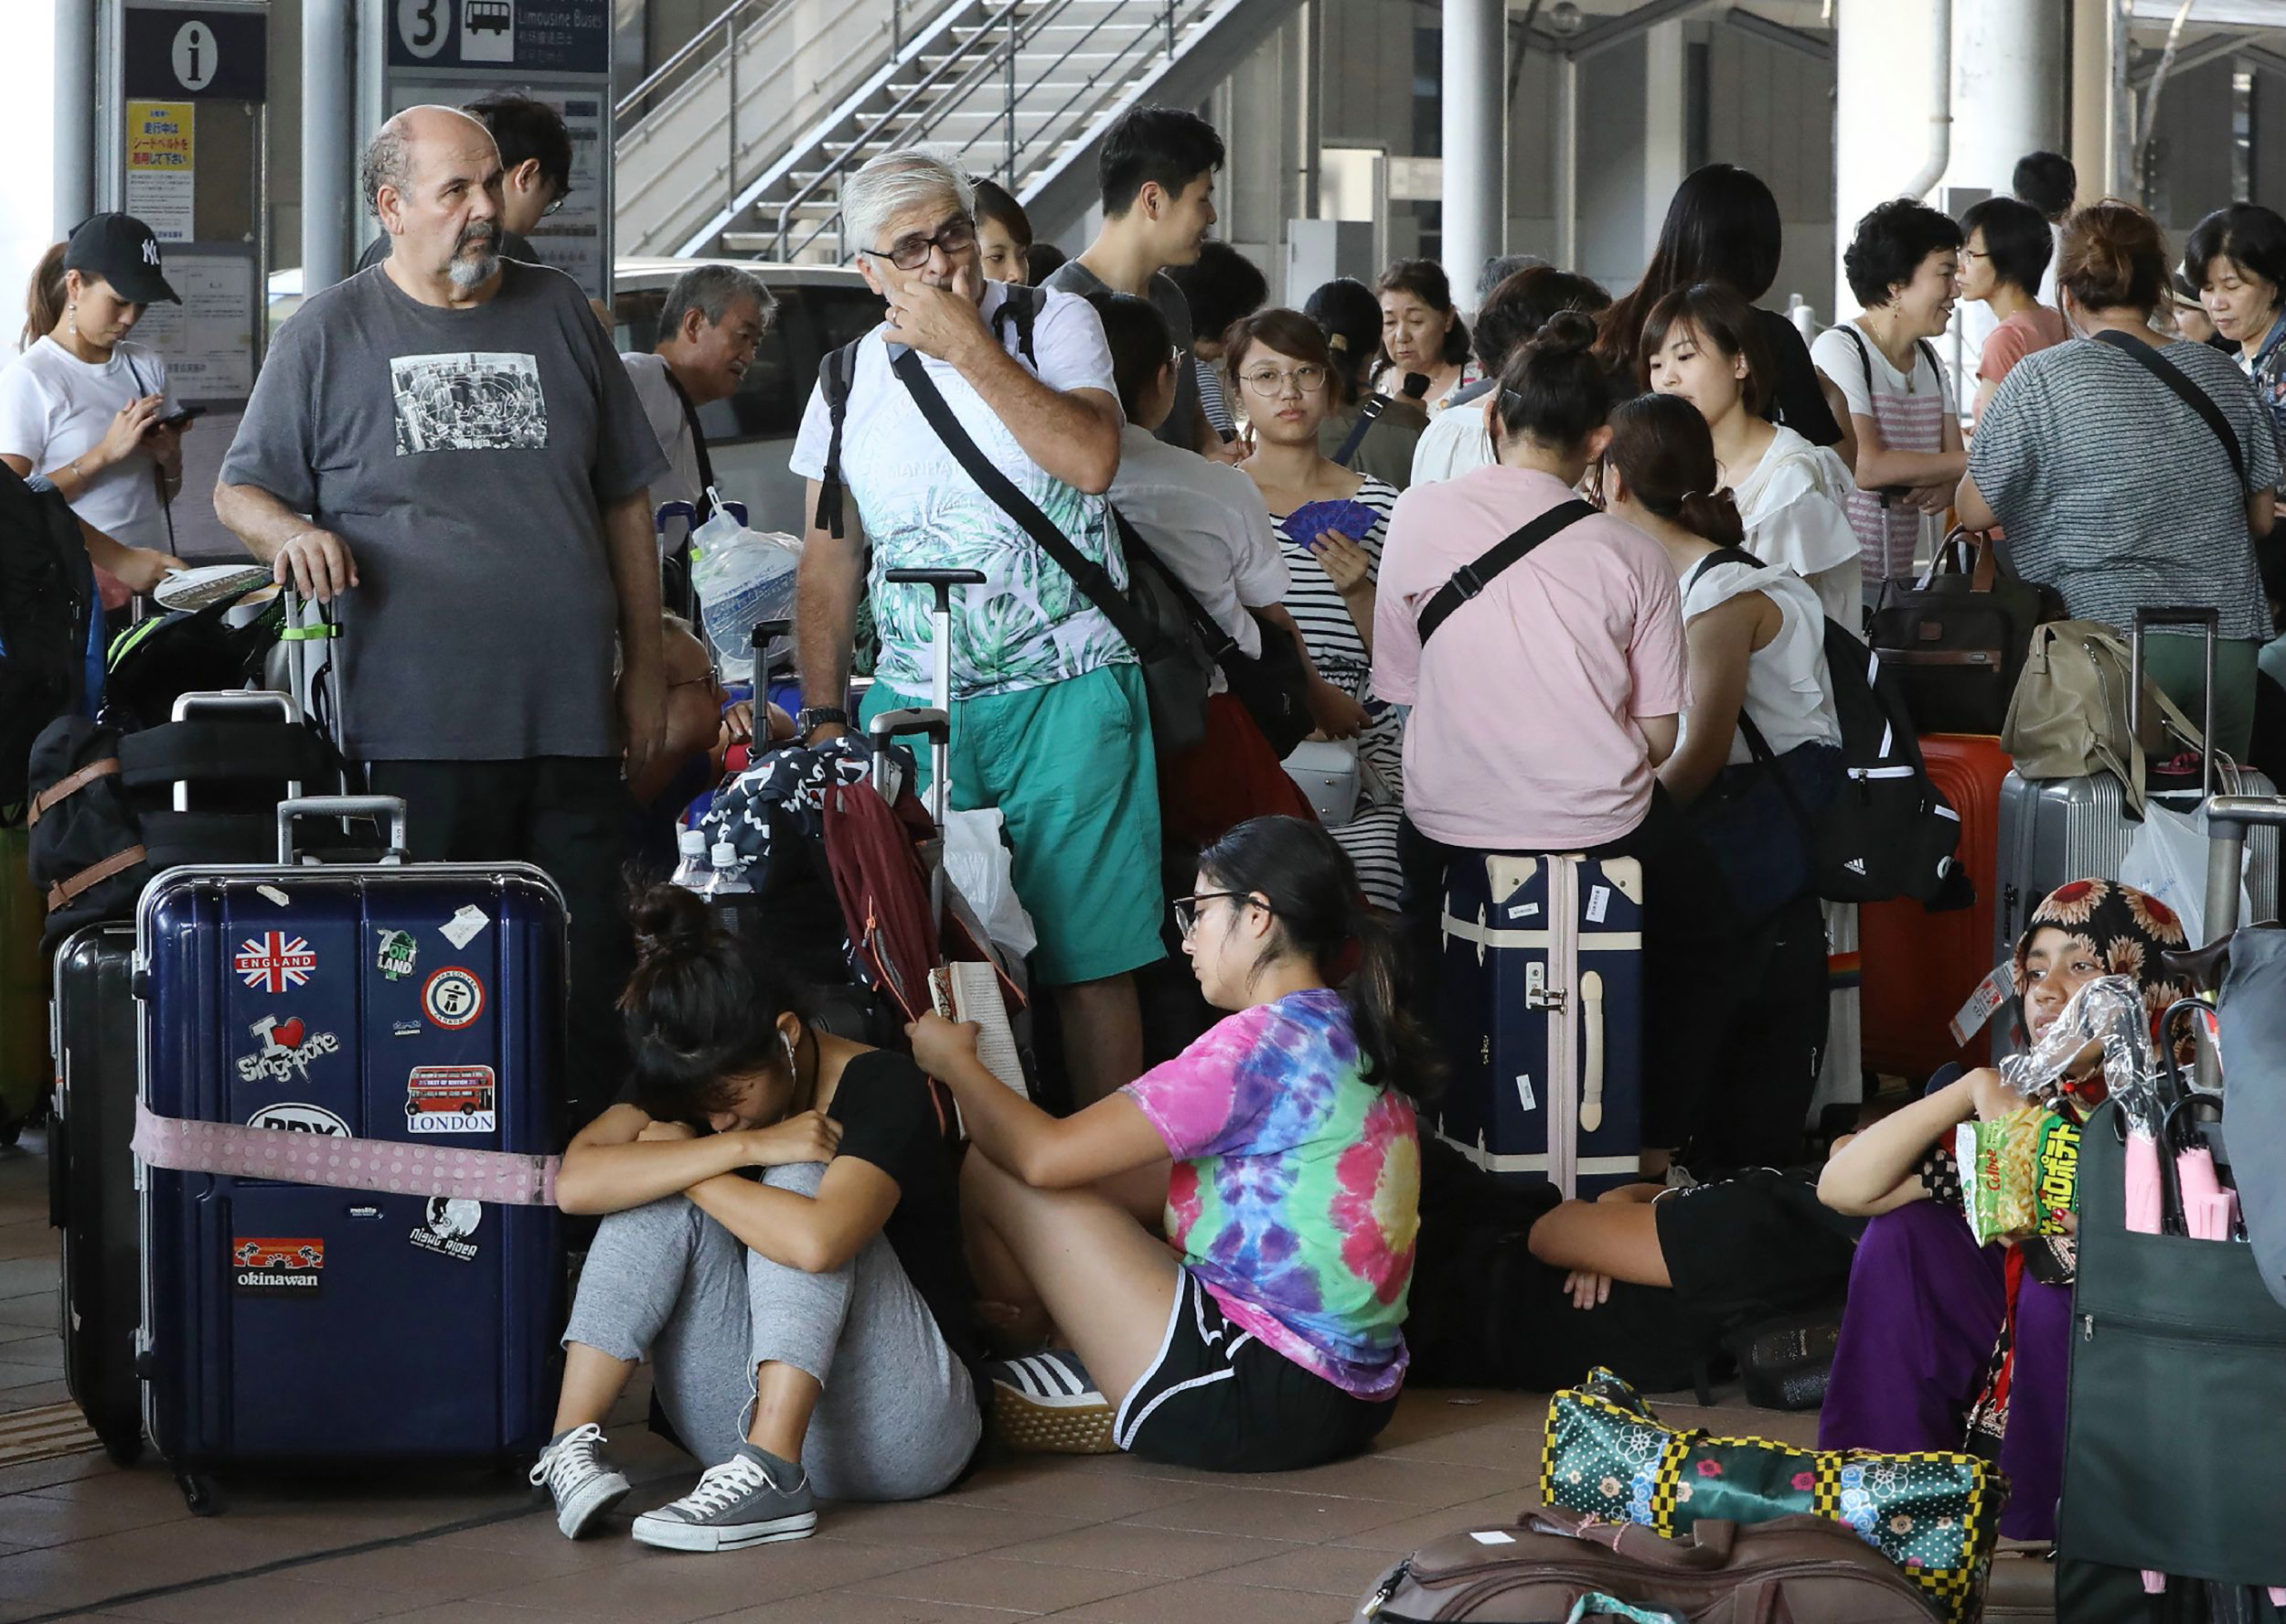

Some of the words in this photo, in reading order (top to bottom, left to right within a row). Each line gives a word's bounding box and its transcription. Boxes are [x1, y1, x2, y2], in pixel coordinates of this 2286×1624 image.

[412, 0, 437, 47] 3
[518, 8, 572, 27] Limousine
[573, 9, 604, 28] Buses
[144, 122, 179, 134] 走行中は
[240, 956, 312, 968] ENGLAND
[378, 955, 413, 975] LAND
[251, 1015, 288, 1058] I
[238, 1032, 339, 1083] Singapore
[410, 1116, 493, 1130] LONDON
[1985, 1149, 2002, 1191] Calbee
[238, 1271, 318, 1287] okinawan
